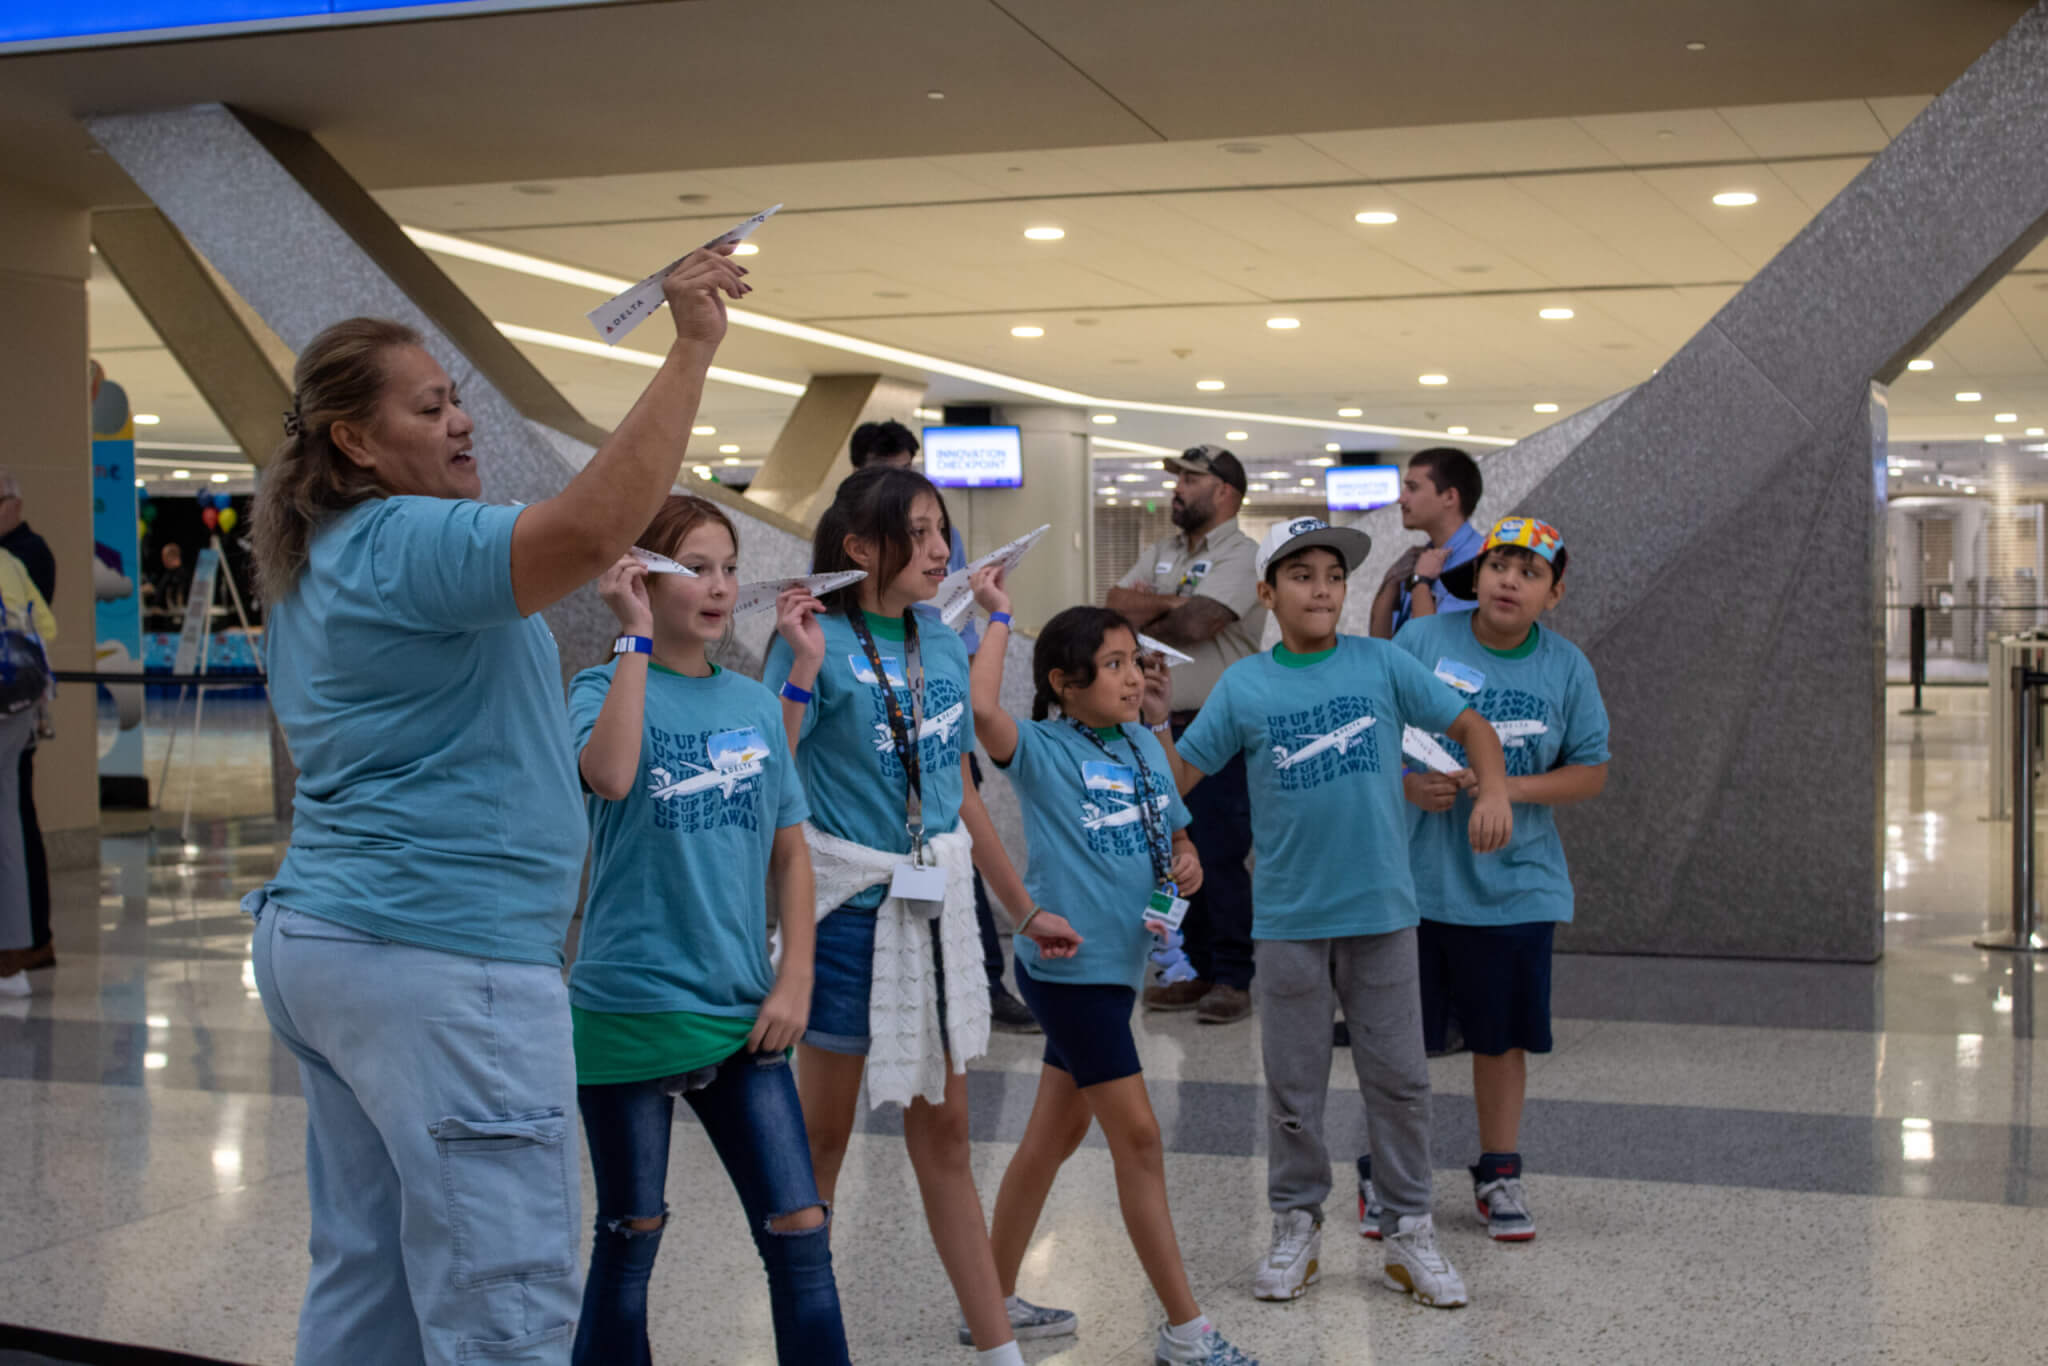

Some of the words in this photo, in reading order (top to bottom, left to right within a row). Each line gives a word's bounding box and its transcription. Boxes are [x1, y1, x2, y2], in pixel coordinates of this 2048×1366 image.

[613, 300, 644, 326] DELTA
[1267, 715, 1286, 727] UP
[1290, 711, 1309, 726] UP
[650, 726, 670, 745] UP
[675, 734, 696, 749] UP
[654, 800, 678, 819] UP
[681, 811, 699, 823] UP
[654, 813, 679, 831] UP
[681, 823, 699, 833] UP
